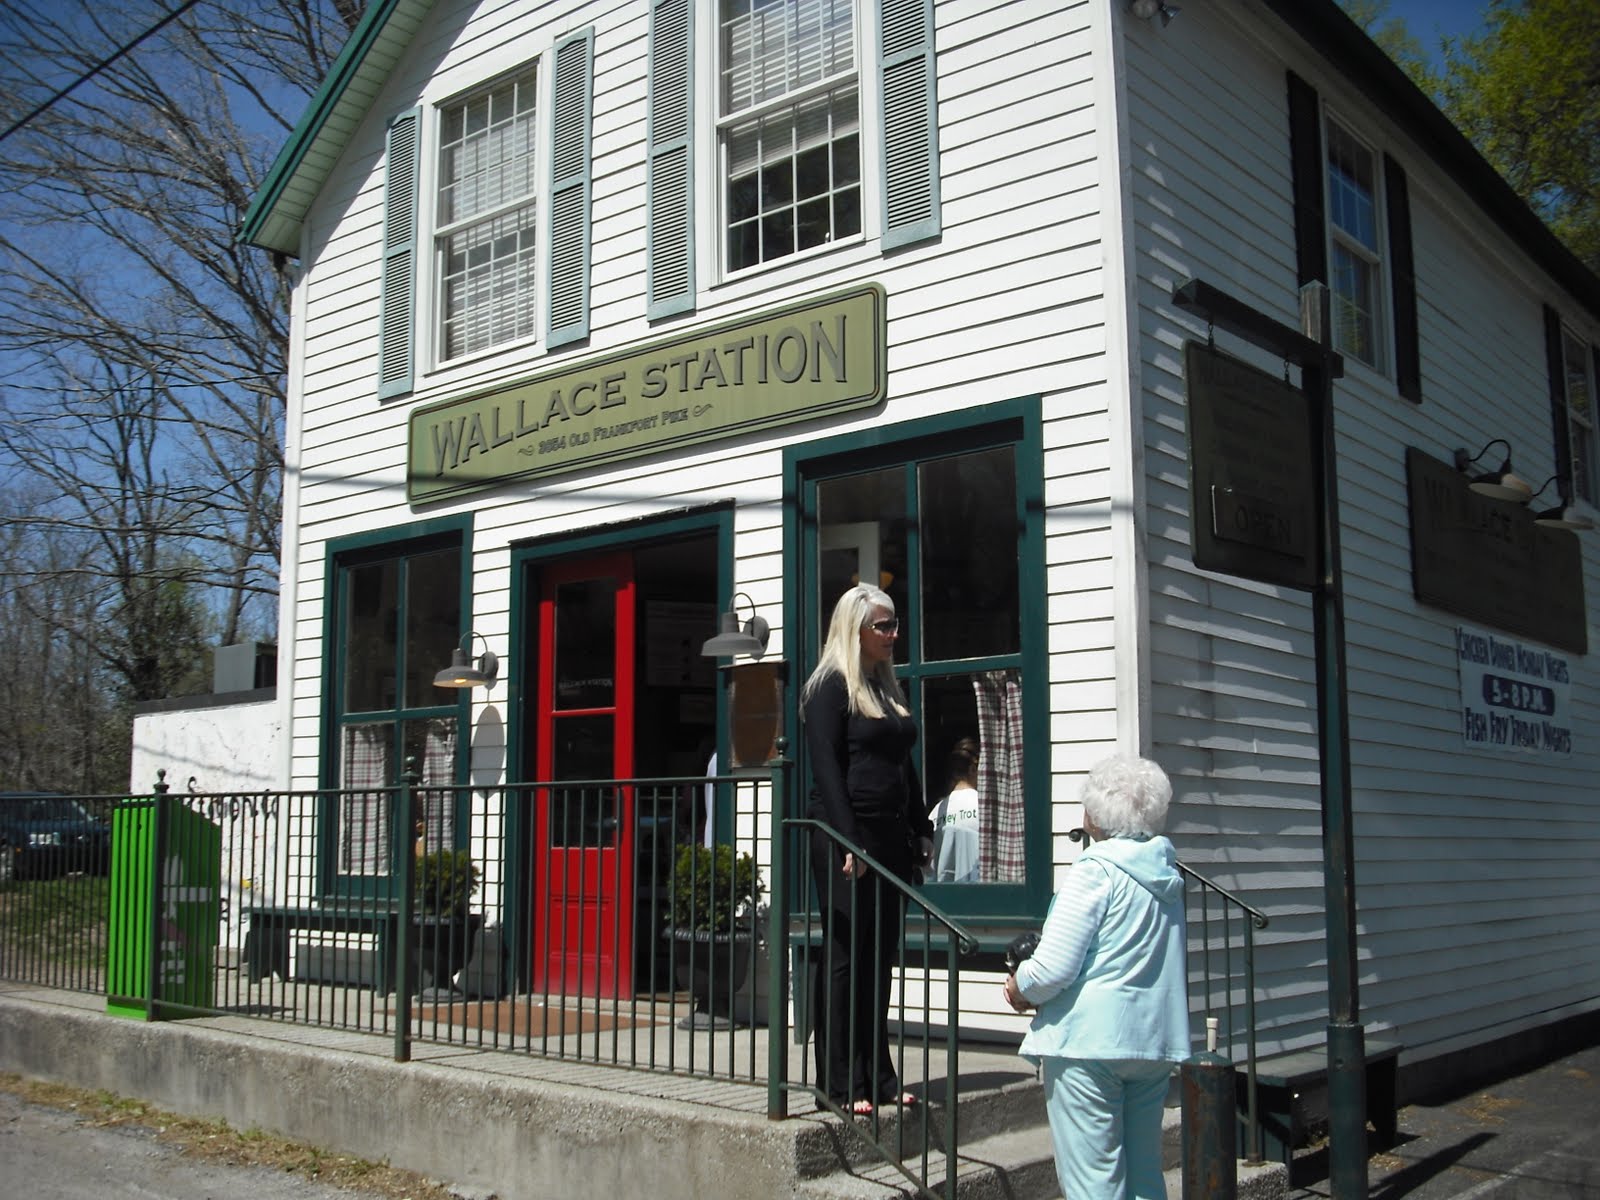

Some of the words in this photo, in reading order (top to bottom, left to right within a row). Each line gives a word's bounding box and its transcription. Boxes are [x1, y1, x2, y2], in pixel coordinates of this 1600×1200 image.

[431, 372, 627, 476] WALLACE
[640, 315, 848, 398] STATION
[569, 432, 591, 447] OLD
[593, 416, 658, 442] FRANKFORT
[661, 409, 688, 426] PIKE
[1235, 505, 1292, 545] OPEN
[1465, 707, 1487, 742] FISH
[1489, 711, 1508, 745] FRY
[1510, 715, 1540, 749] FRIDAY
[959, 809, 977, 820] Trot
